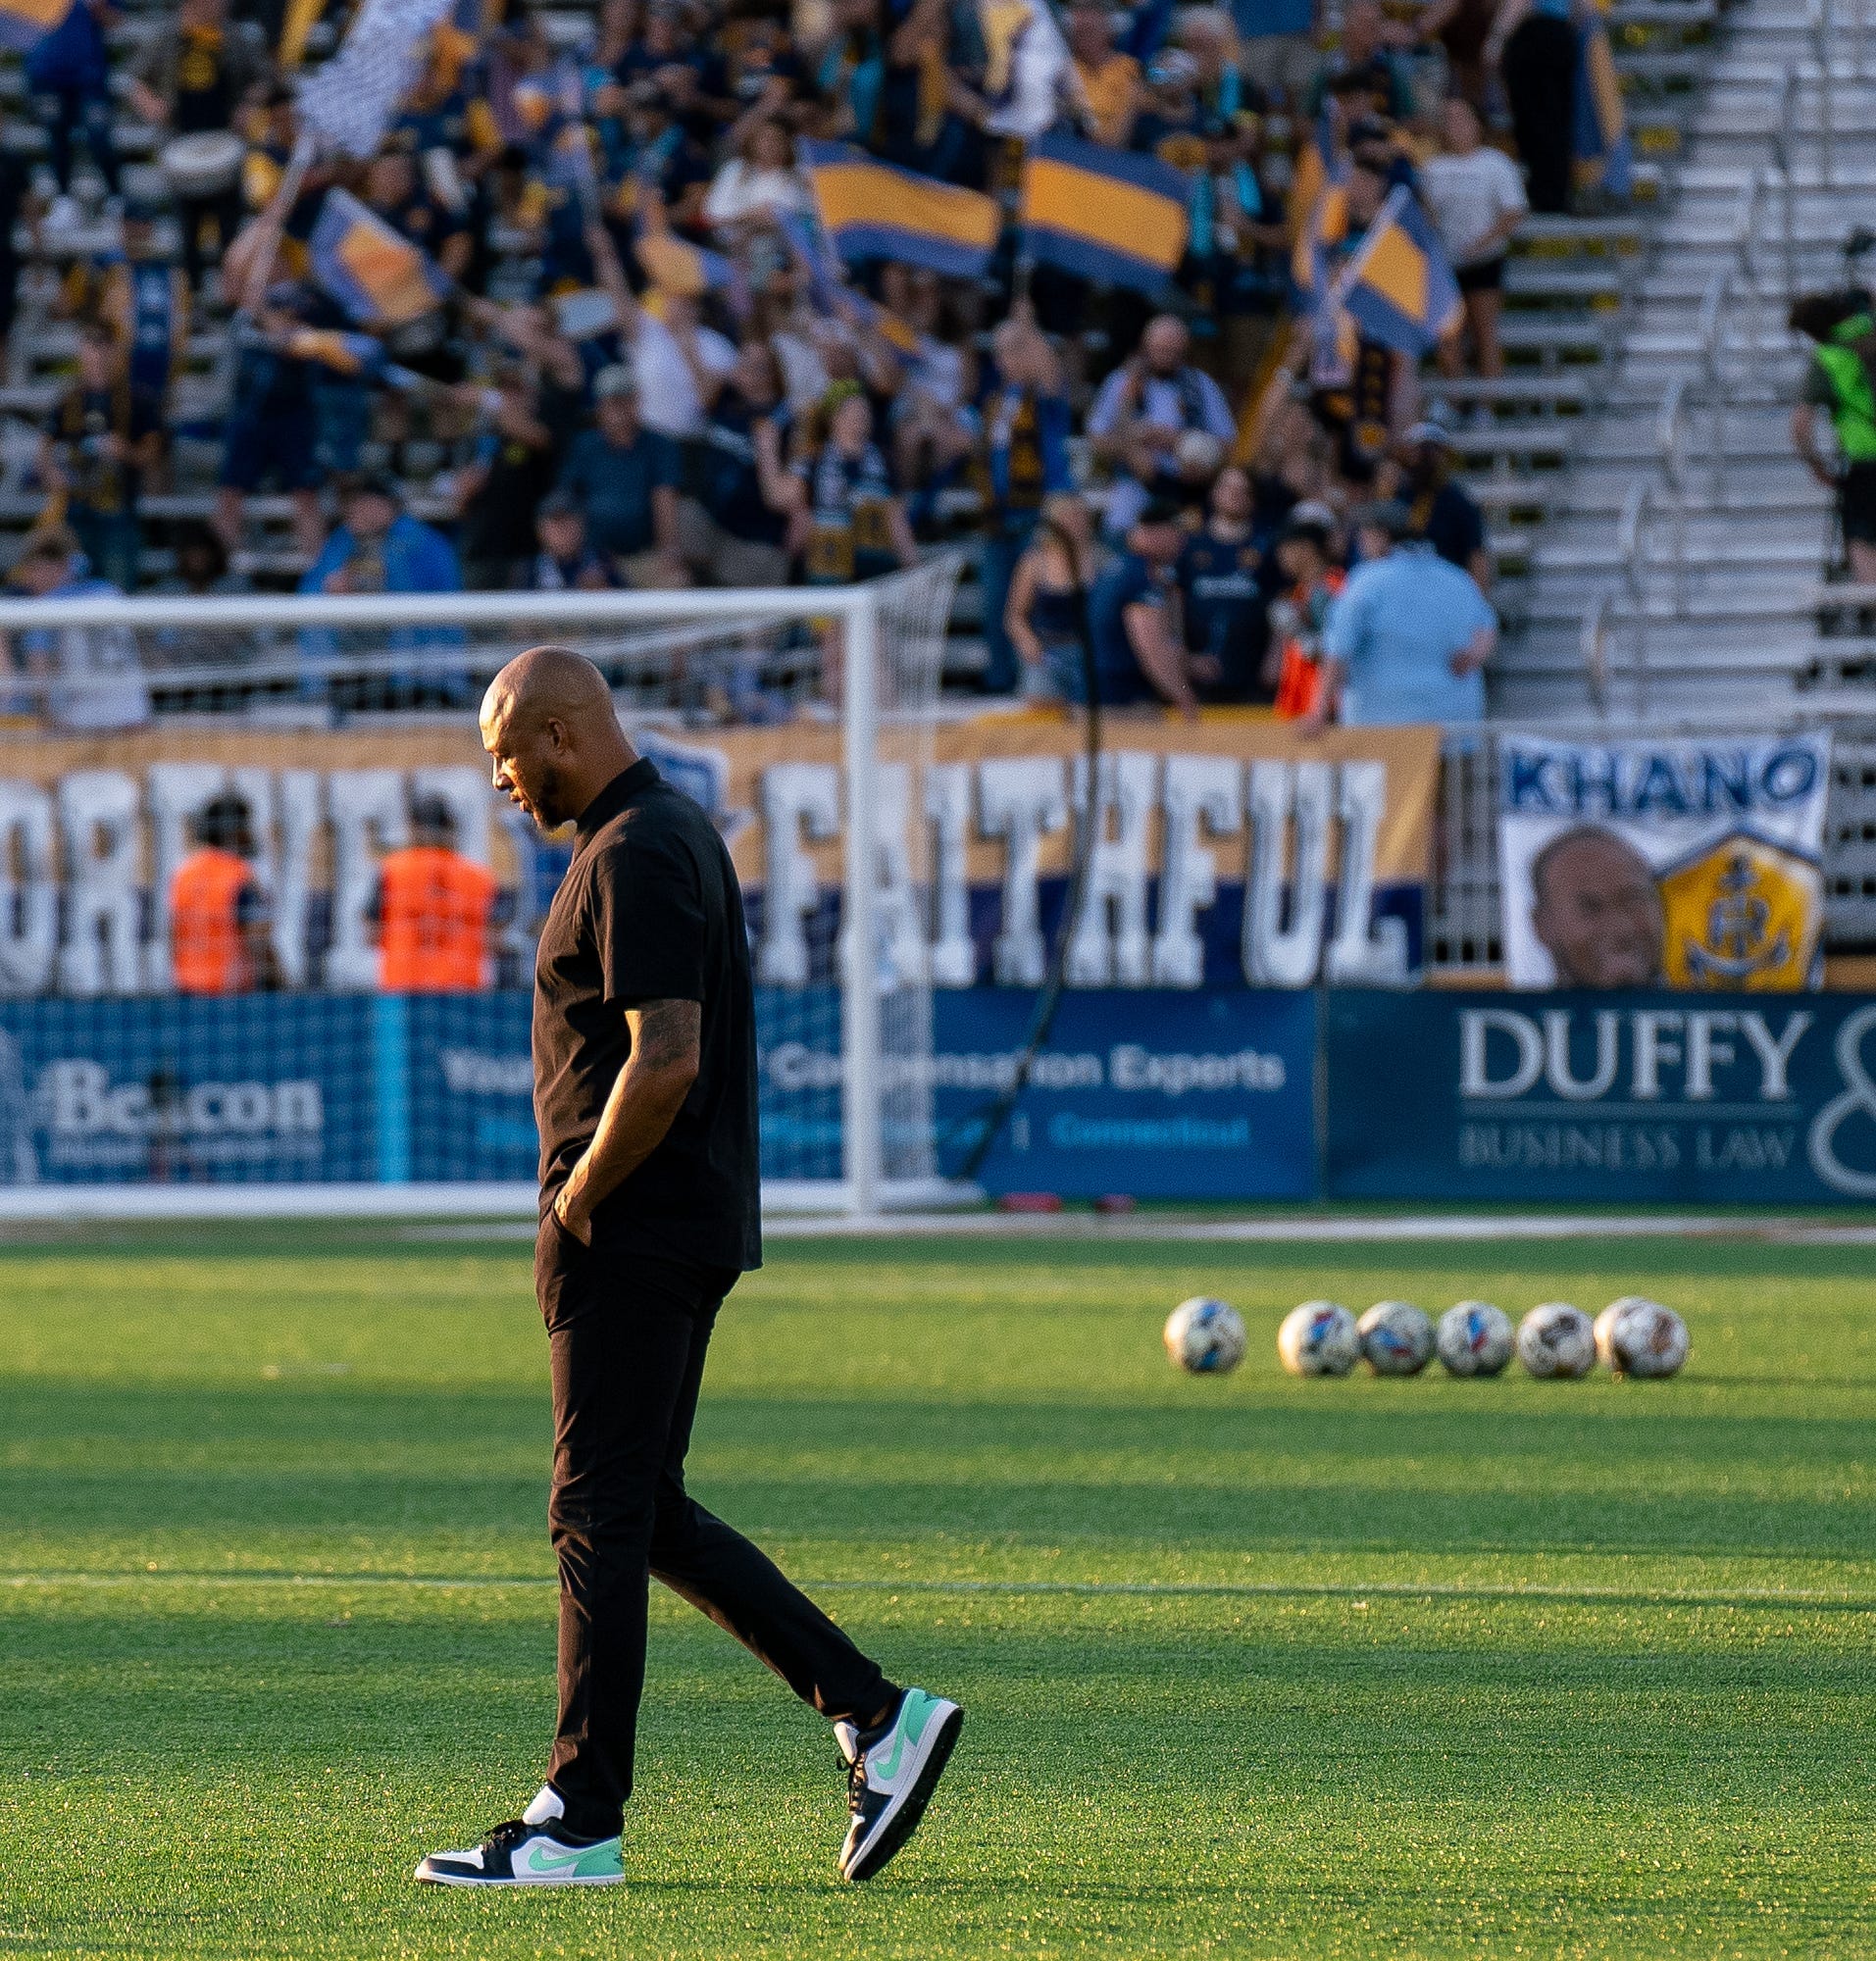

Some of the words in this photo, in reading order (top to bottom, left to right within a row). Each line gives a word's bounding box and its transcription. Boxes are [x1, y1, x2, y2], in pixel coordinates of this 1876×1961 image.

[1510, 747, 1817, 815] KHANO
[759, 753, 1410, 991] FAITHFUL
[441, 1047, 534, 1094] You
[769, 1042, 1102, 1095] Copensaion
[1109, 1044, 1286, 1097] Experts
[1459, 1008, 1814, 1100] DUFFY
[1459, 1124, 1682, 1171] BUSINESS
[1695, 1125, 1796, 1171] LAW
